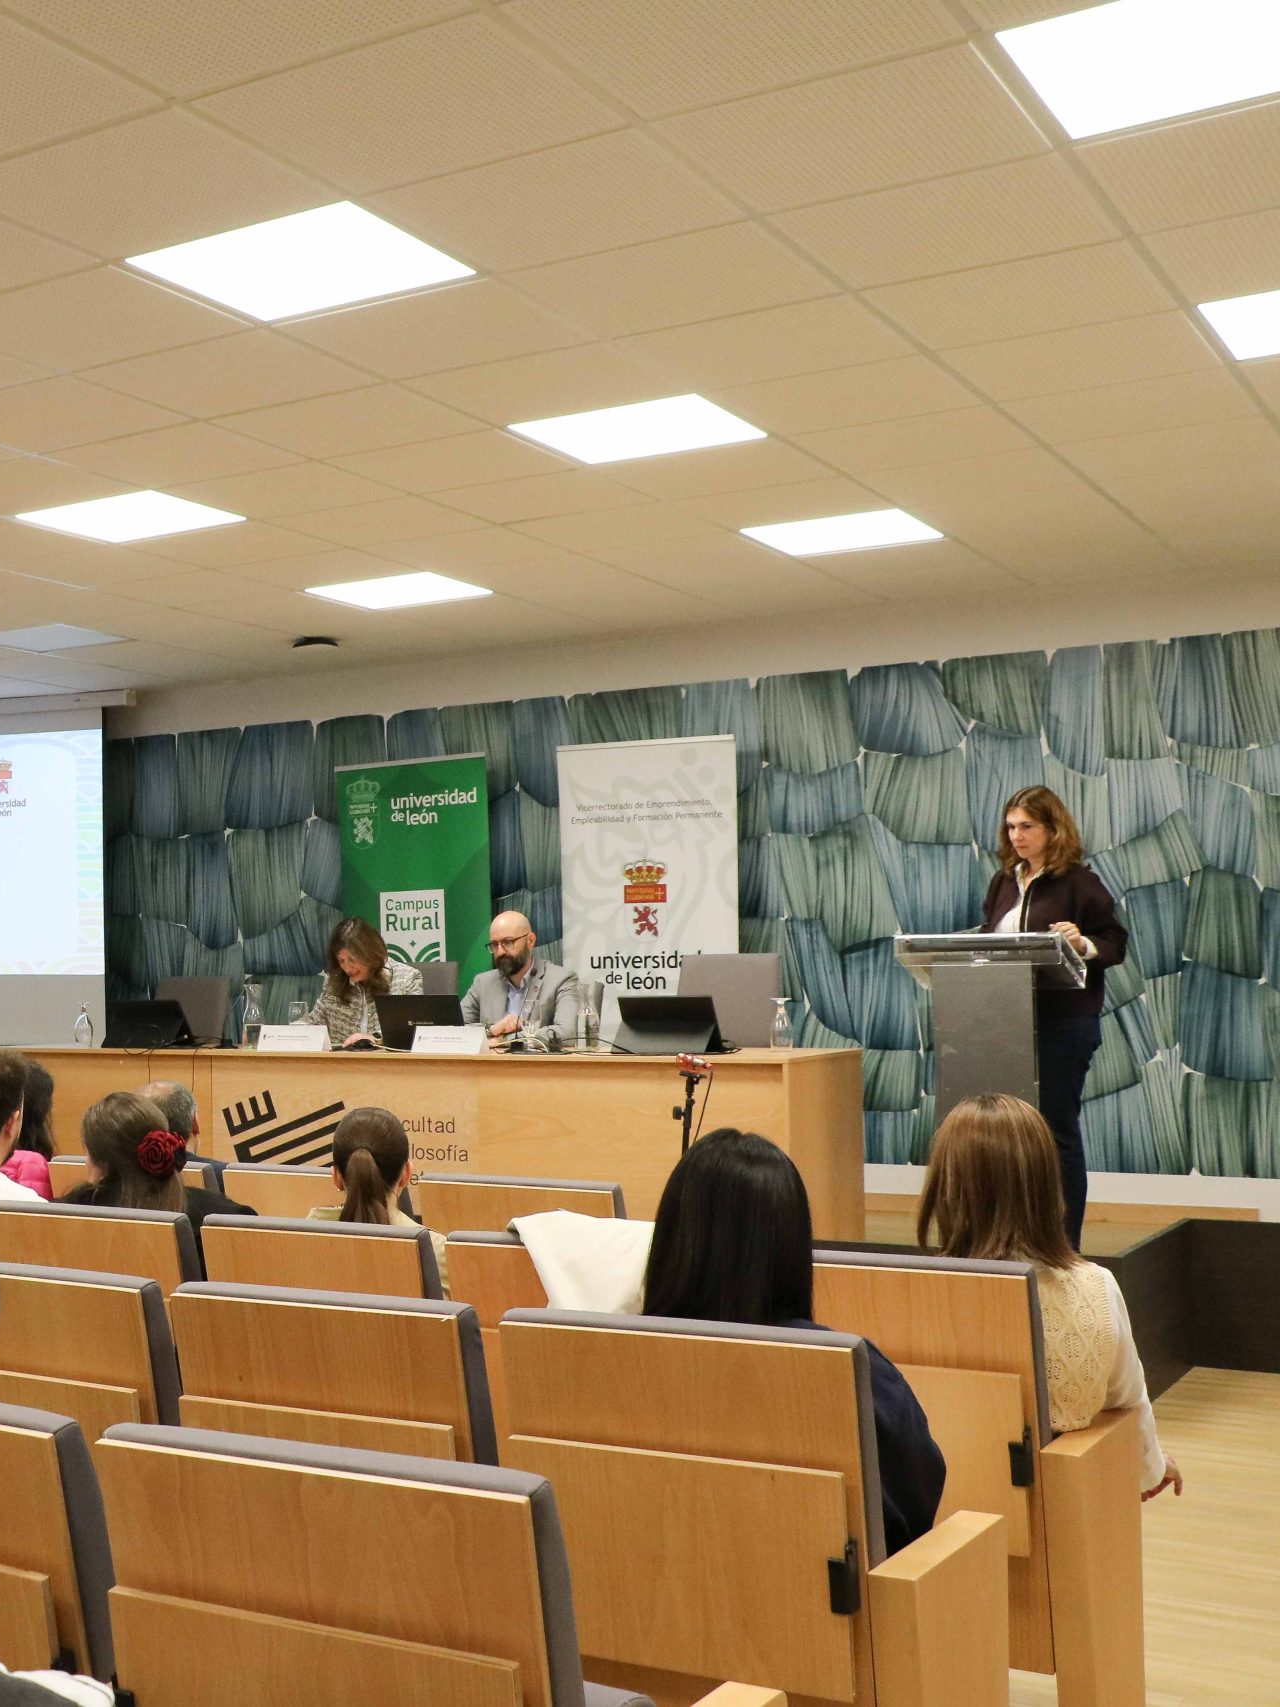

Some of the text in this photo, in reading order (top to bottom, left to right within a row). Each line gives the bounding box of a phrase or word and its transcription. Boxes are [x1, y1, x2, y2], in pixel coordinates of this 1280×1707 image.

[390, 787, 477, 809] universidad
[576, 803, 633, 812] Vicerrectorado
[391, 809, 438, 826] de león
[571, 815, 625, 825] Empleabilidad
[633, 813, 673, 822] Formación
[676, 811, 723, 820] Permanente
[385, 898, 440, 913] Campus
[385, 911, 440, 932] Rural
[590, 950, 701, 969] universid
[605, 971, 667, 990] de león
[401, 1116, 456, 1134] cultad
[411, 1143, 469, 1162] losofía
